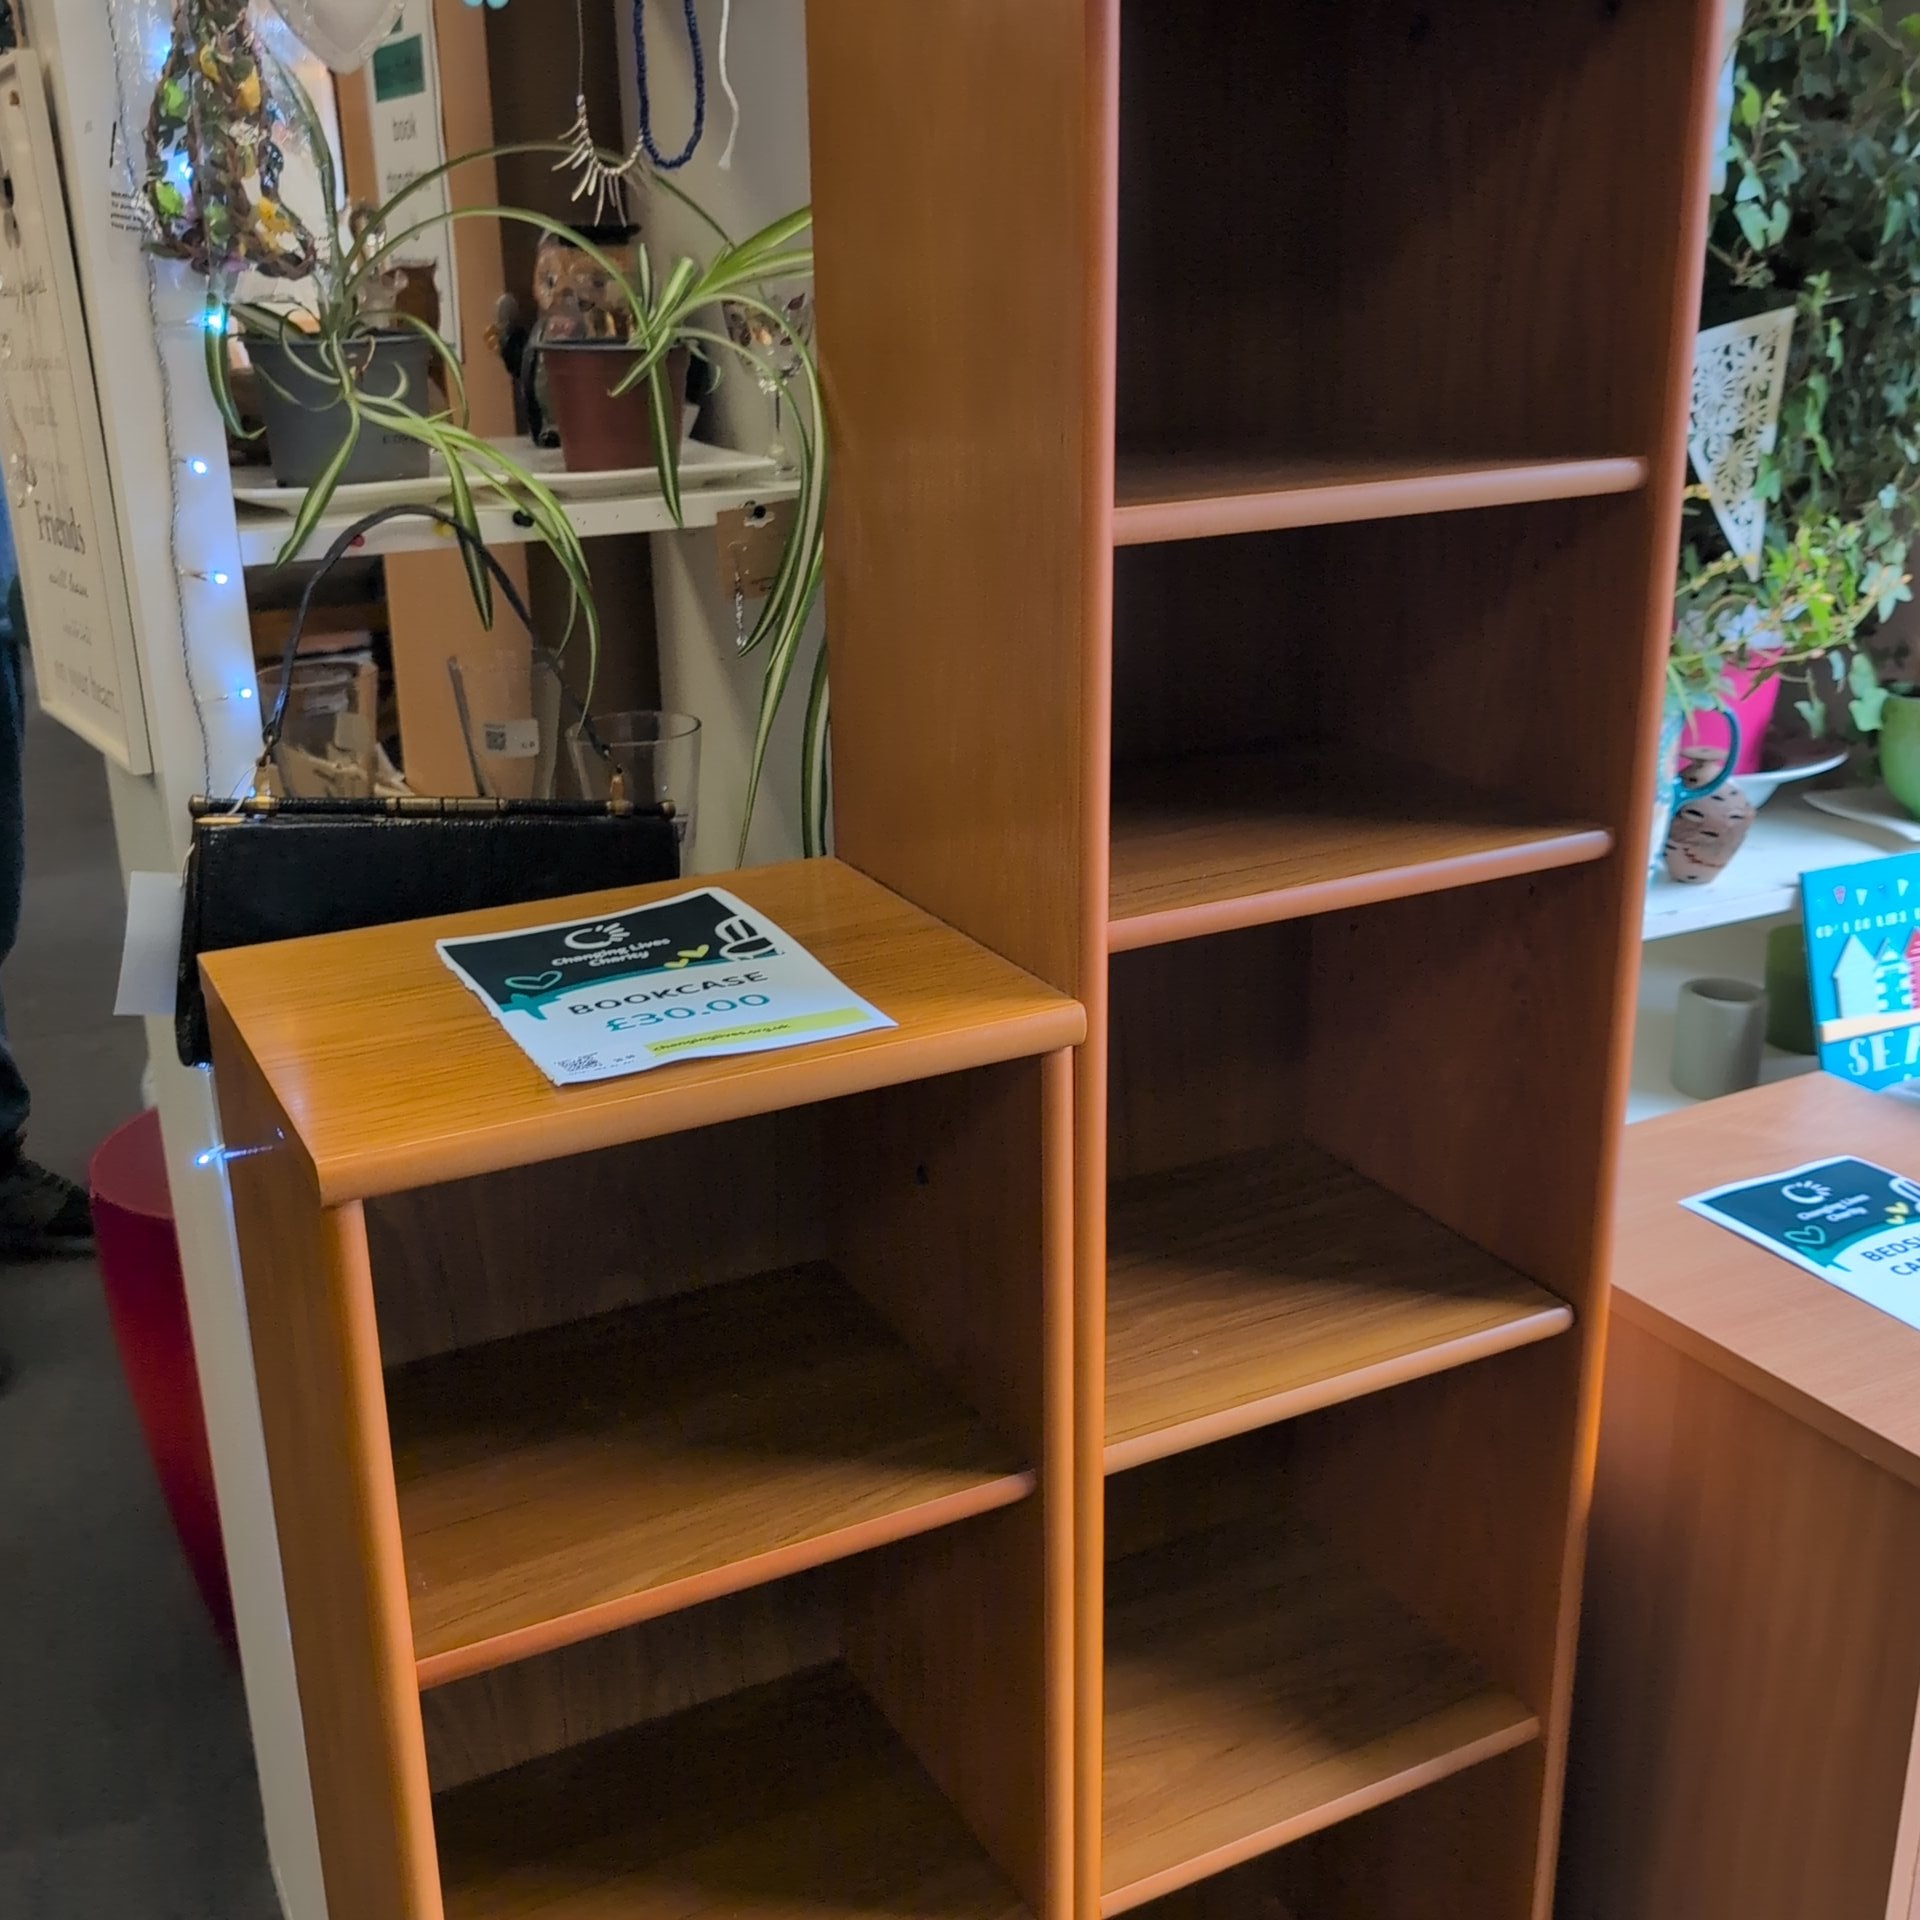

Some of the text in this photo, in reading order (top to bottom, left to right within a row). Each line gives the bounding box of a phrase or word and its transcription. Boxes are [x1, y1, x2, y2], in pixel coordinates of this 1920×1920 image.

[34, 499, 86, 555] Friends
[551, 938, 671, 966] Changing Lives
[588, 951, 649, 967] Charity
[567, 970, 770, 1016] BOOKCASE
[605, 993, 771, 1032] £30.00
[1889, 1258, 1920, 1276] CA
